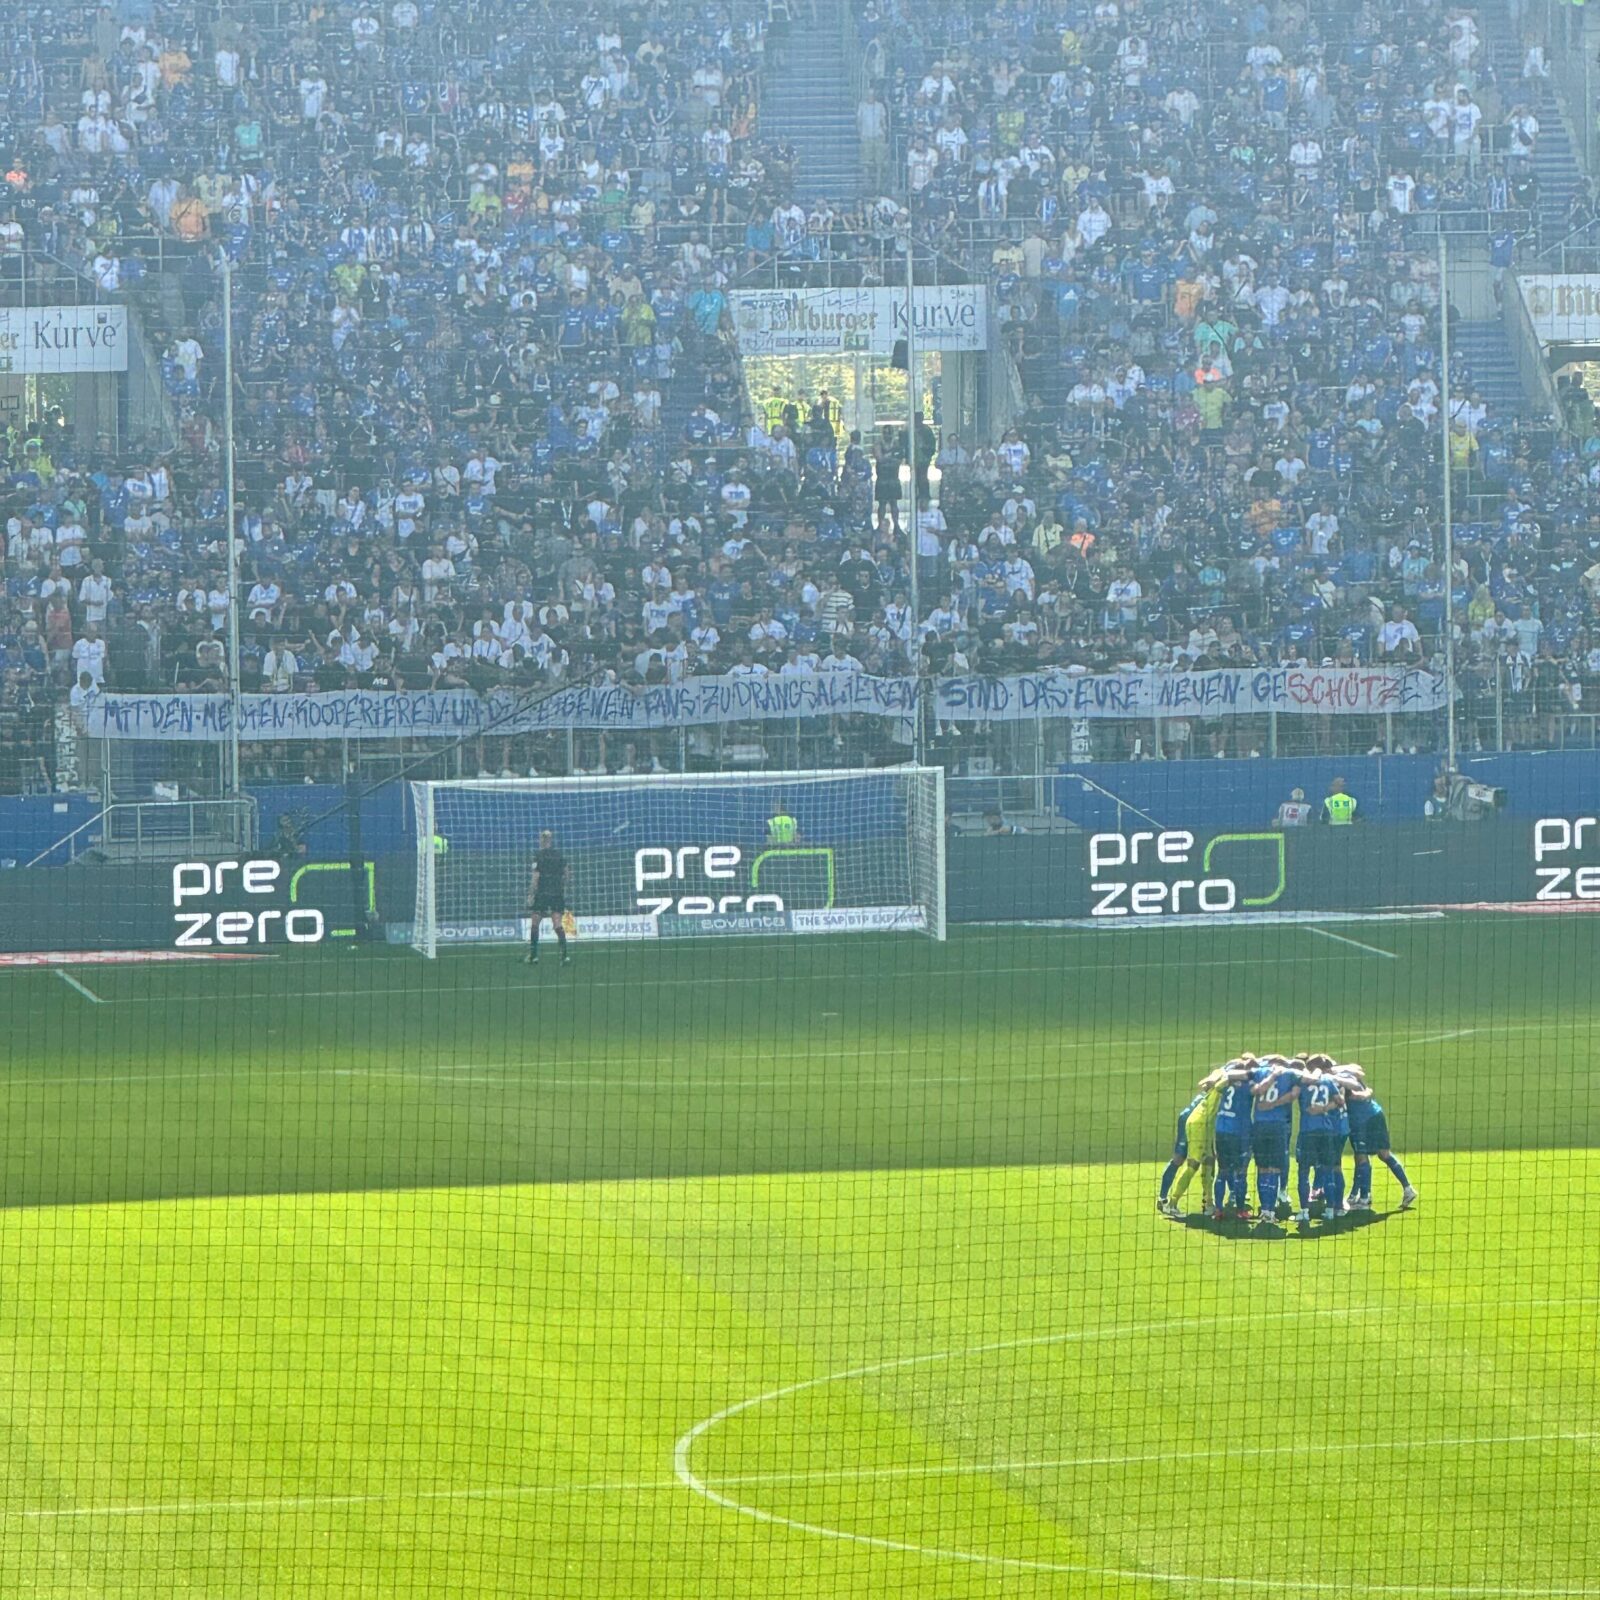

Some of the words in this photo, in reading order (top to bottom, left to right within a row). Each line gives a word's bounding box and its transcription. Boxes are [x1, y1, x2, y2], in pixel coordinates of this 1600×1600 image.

[893, 301, 976, 328] Kurve
[34, 320, 117, 349] Kurve
[1019, 675, 1070, 712] DAS
[1159, 671, 1242, 707] NEUEN
[151, 697, 193, 734] DEN
[1089, 830, 1195, 877] pre
[1534, 817, 1597, 861] pr
[173, 859, 281, 907] pre
[635, 845, 742, 892] pre
[1535, 866, 1600, 900] ze
[1090, 878, 1236, 916] zero
[173, 908, 325, 947] zero
[1223, 1085, 1236, 1110] 3
[1308, 1084, 1329, 1109] 23
